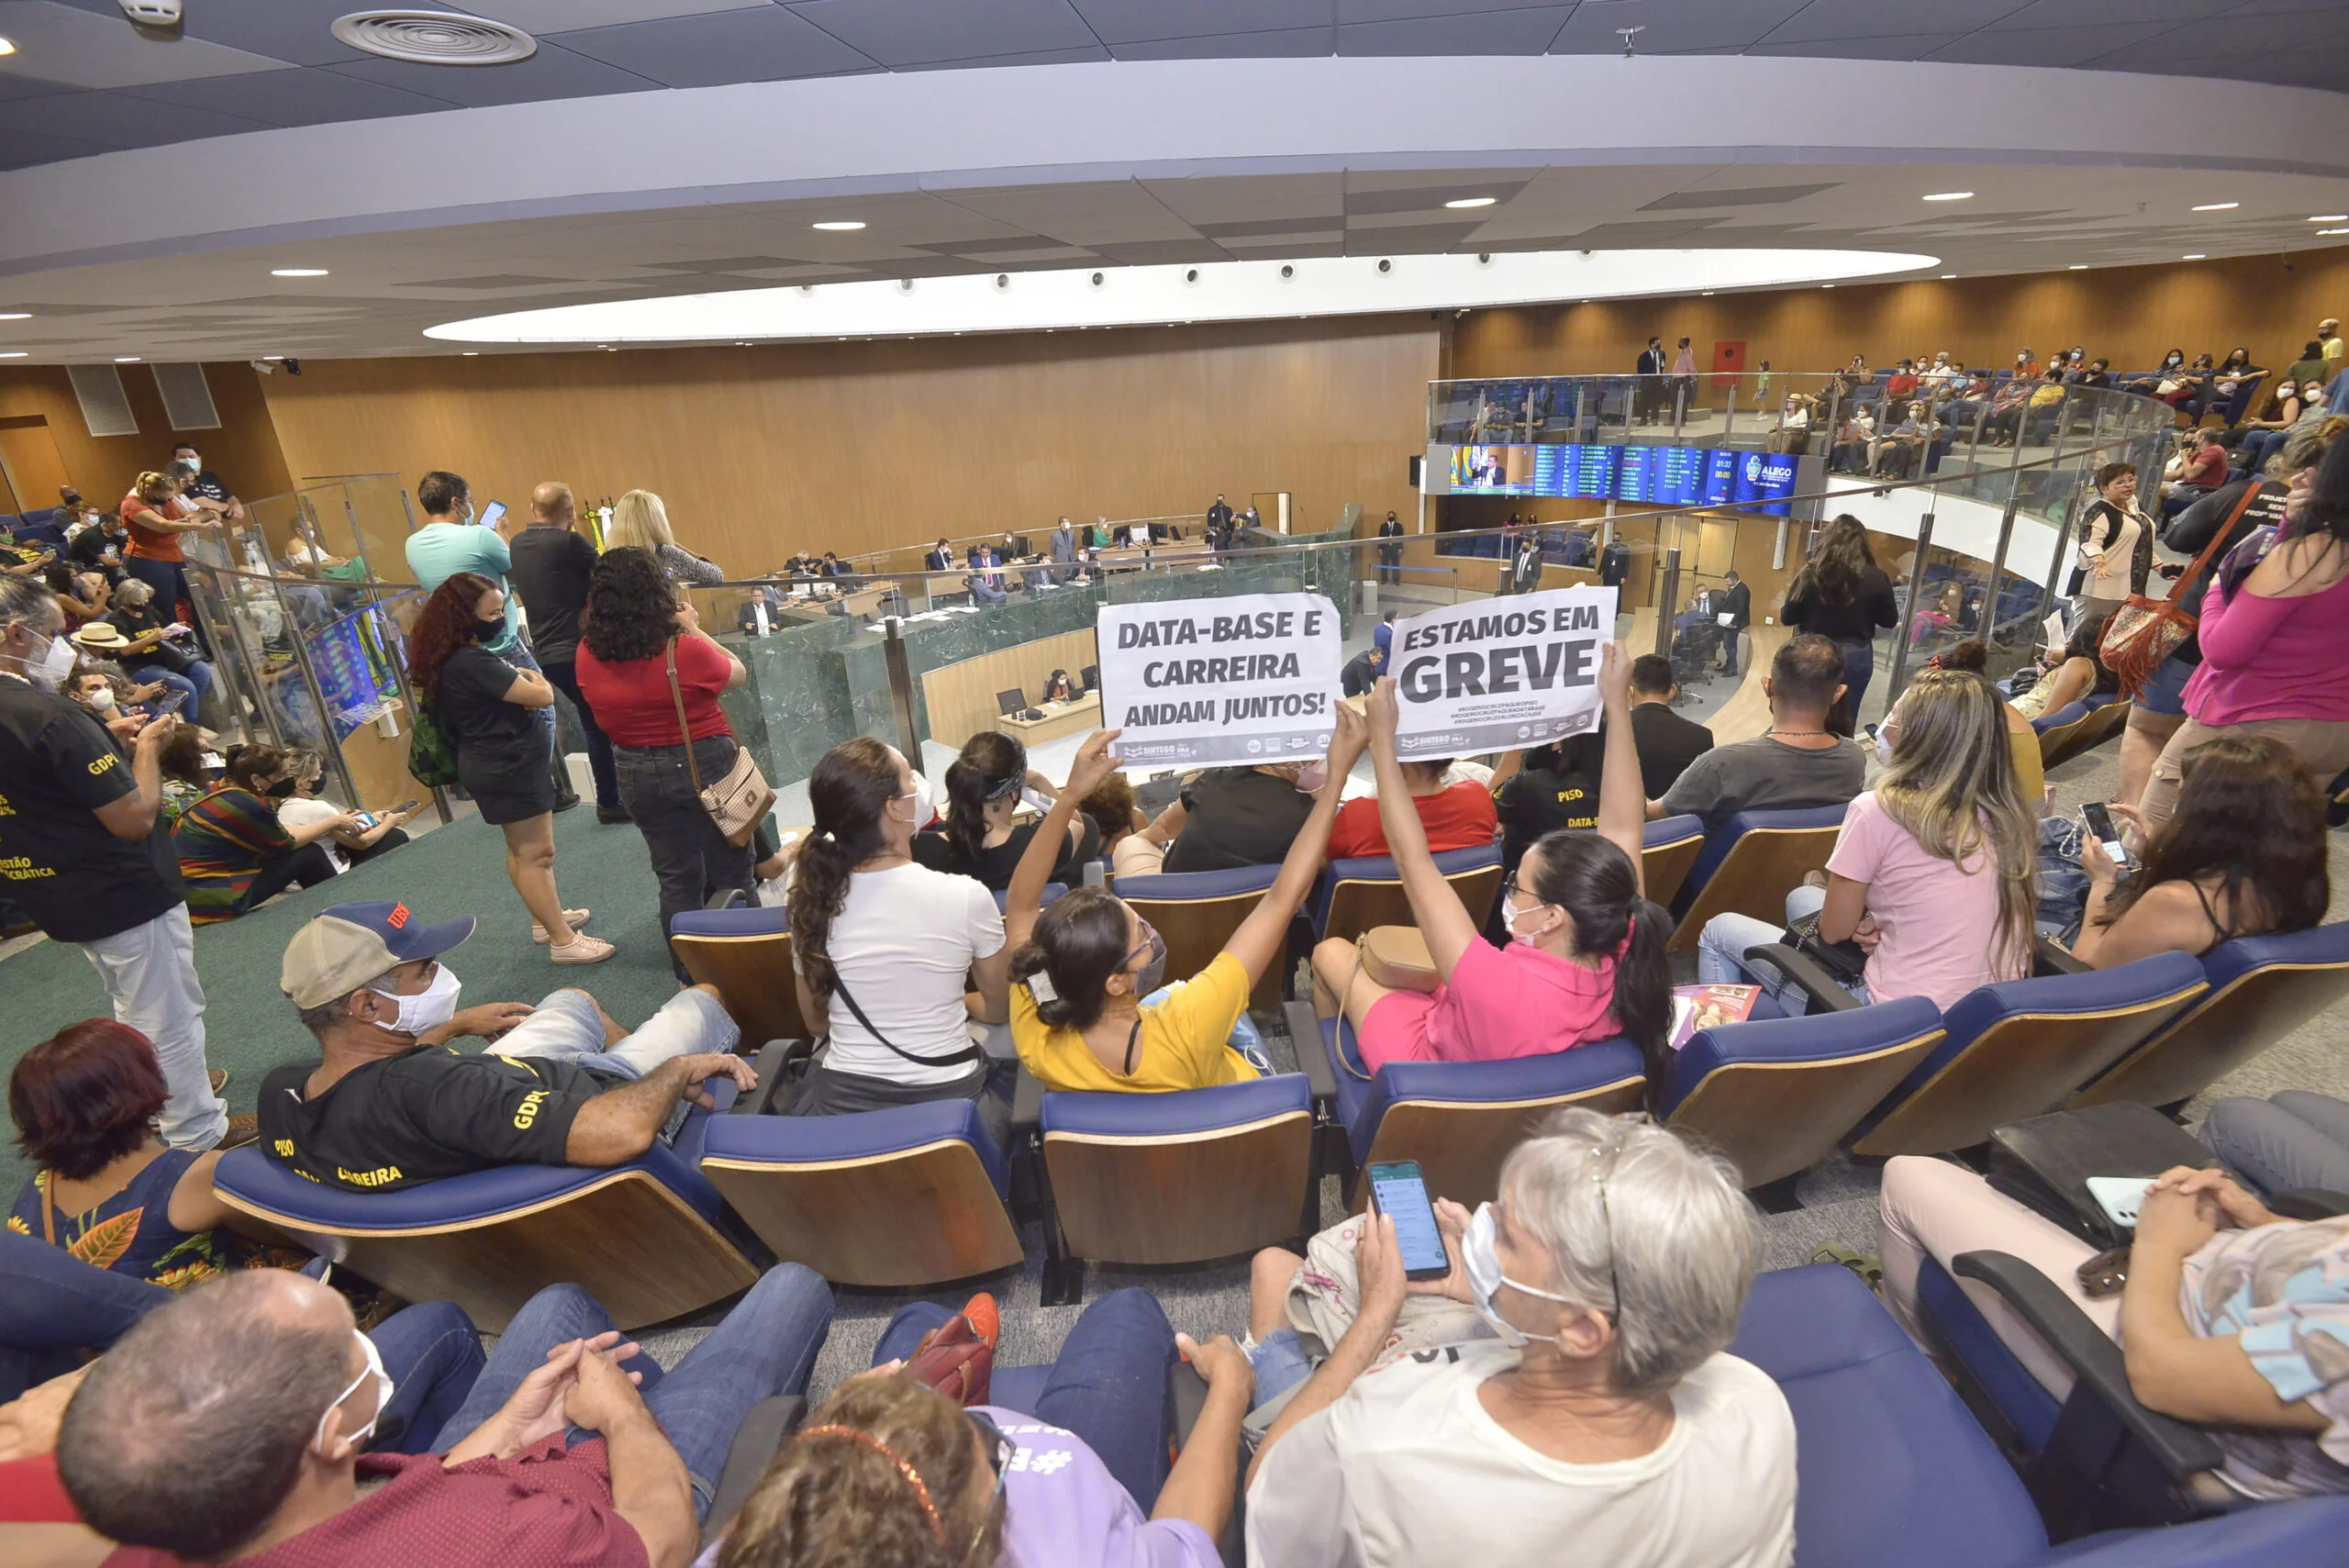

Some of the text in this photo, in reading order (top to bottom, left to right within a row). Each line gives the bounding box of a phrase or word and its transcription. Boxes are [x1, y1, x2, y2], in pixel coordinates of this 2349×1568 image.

[1762, 465, 1792, 476] ALEGO
[1118, 610, 1322, 650] DATA-BASE E
[1404, 605, 1598, 652] ESTAMOS EM
[1143, 652, 1300, 688] CARREIRA
[1400, 639, 1597, 704] GREVE
[1124, 692, 1327, 728] ANDAM JUNTOS!
[1143, 744, 1175, 755] SINTEGO
[1557, 788, 1584, 802] PISO
[0, 856, 31, 869] STÃO
[0, 867, 57, 880] CRÁTICA
[274, 1139, 294, 1156] PISO
[338, 1165, 403, 1186] CREIRA
